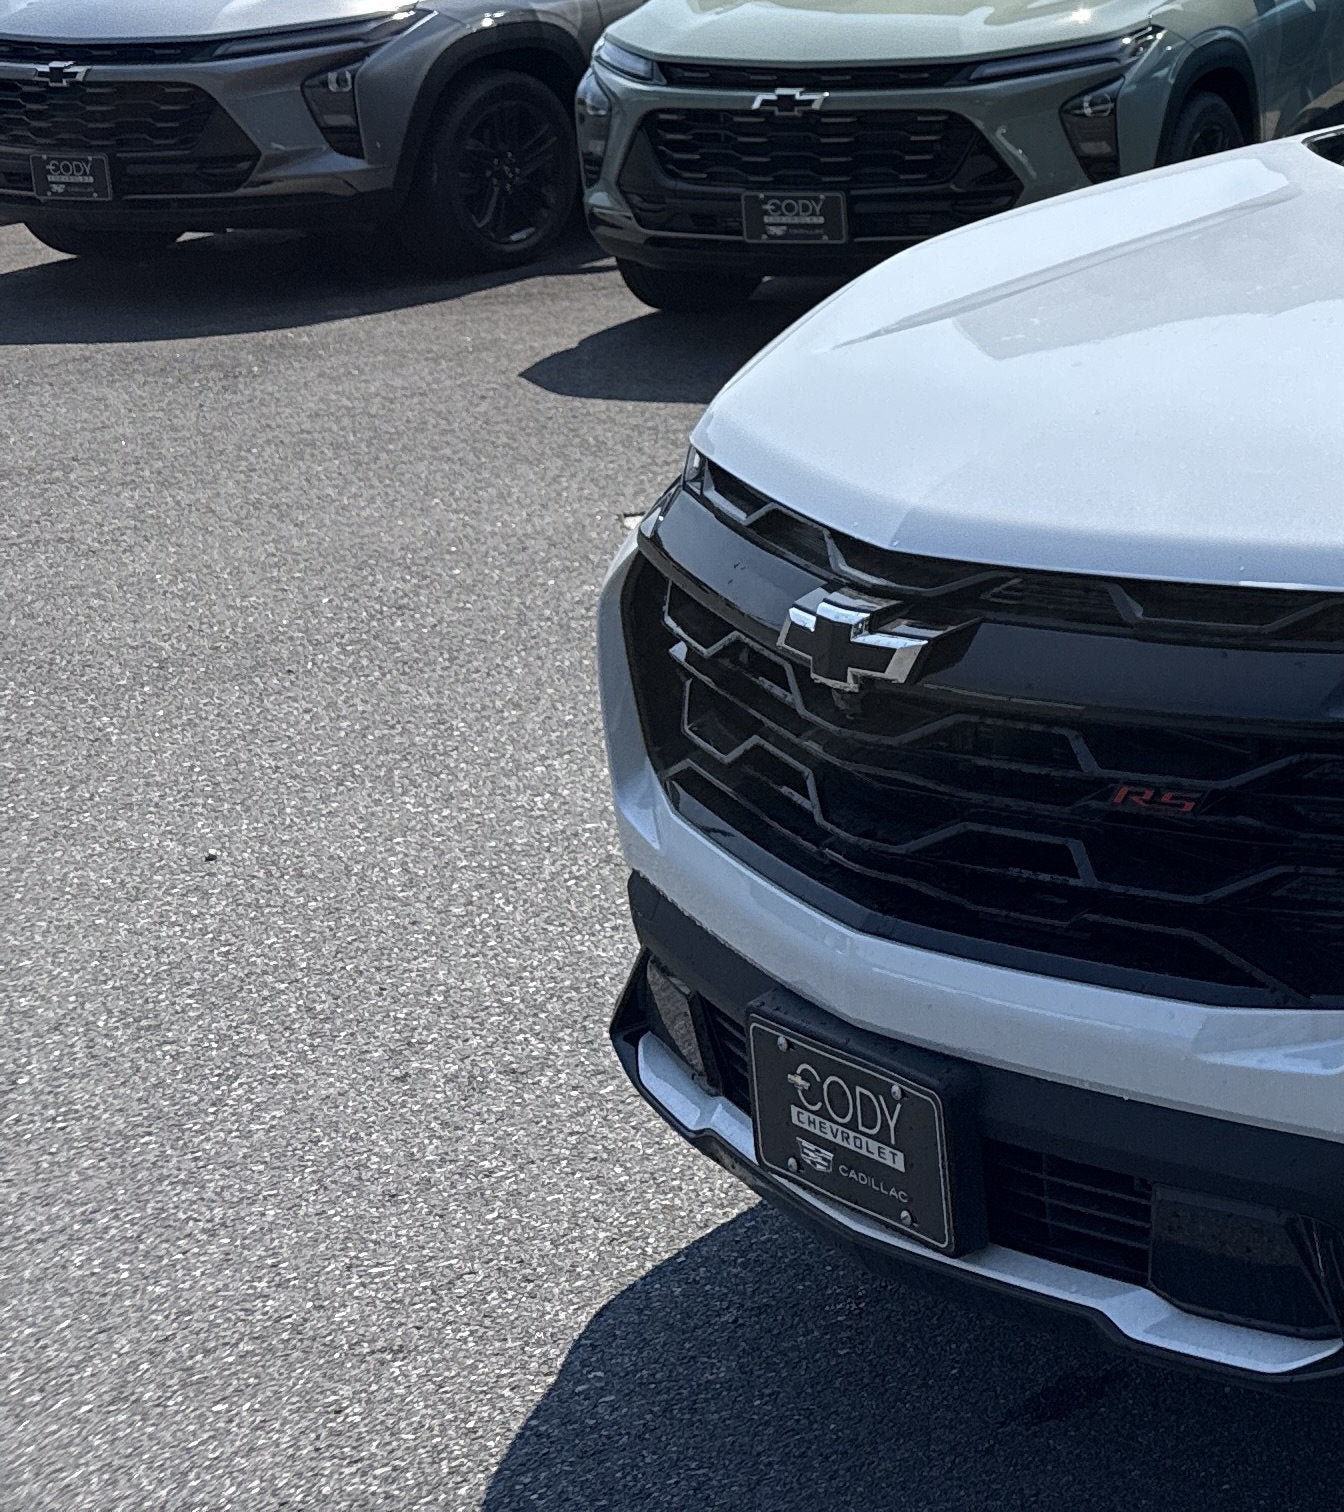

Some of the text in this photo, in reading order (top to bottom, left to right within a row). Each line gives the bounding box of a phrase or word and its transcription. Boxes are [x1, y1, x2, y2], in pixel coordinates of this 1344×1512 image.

[47, 160, 92, 176] CODY
[765, 199, 824, 217] CODY
[1111, 784, 1201, 813] RS
[794, 1064, 902, 1145] CODY
[795, 1110, 899, 1166] CHEVROLET
[838, 1164, 909, 1203] CADILLAC
